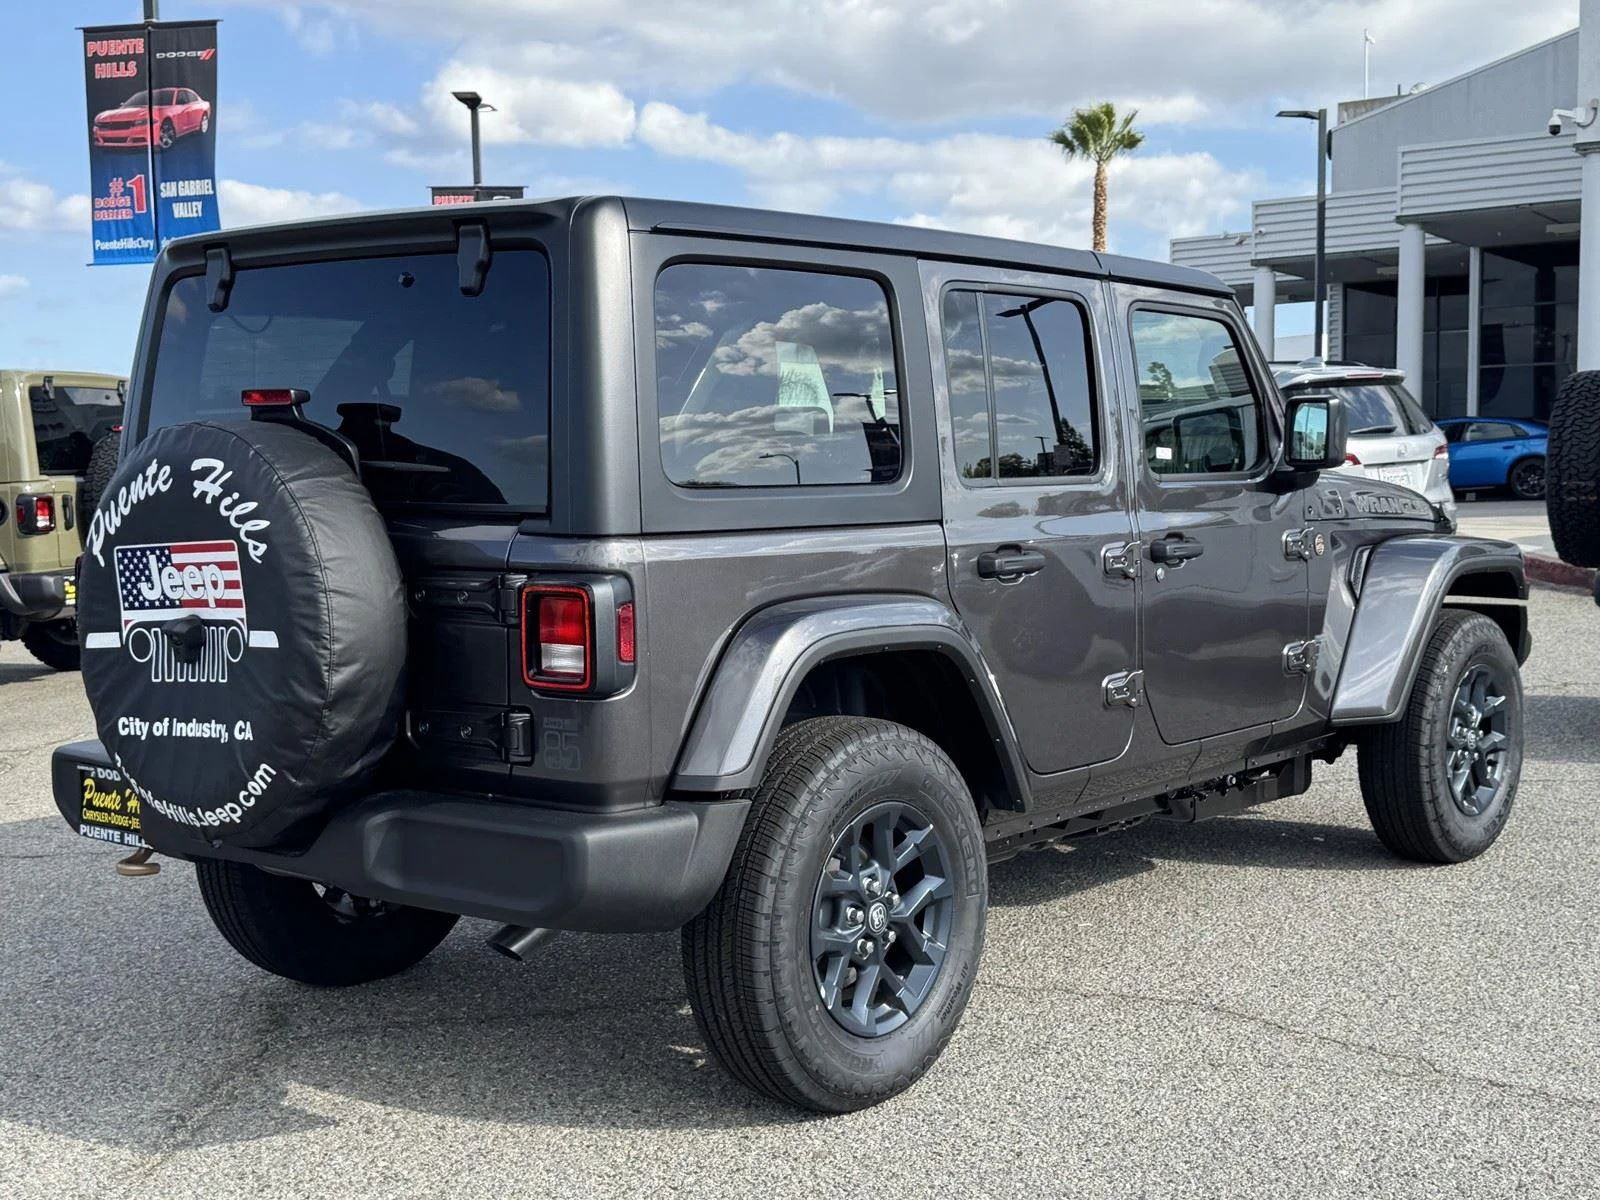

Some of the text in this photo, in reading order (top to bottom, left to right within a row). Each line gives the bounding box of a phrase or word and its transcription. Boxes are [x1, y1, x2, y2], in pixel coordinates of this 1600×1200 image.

[86, 38, 145, 57] PUENTE
[156, 51, 204, 59] DODGE
[95, 61, 138, 79] HILLS
[160, 179, 214, 198] SAN GABRIEL
[95, 196, 131, 208] DODGE
[172, 201, 203, 219] VALLEY
[94, 209, 134, 220] DEALER
[87, 458, 271, 567] Puente Hills
[138, 554, 225, 609] Jeep
[118, 717, 254, 744] City of Industry, CA
[83, 778, 121, 810] Puente
[80, 824, 154, 849] PUENTE HILL
